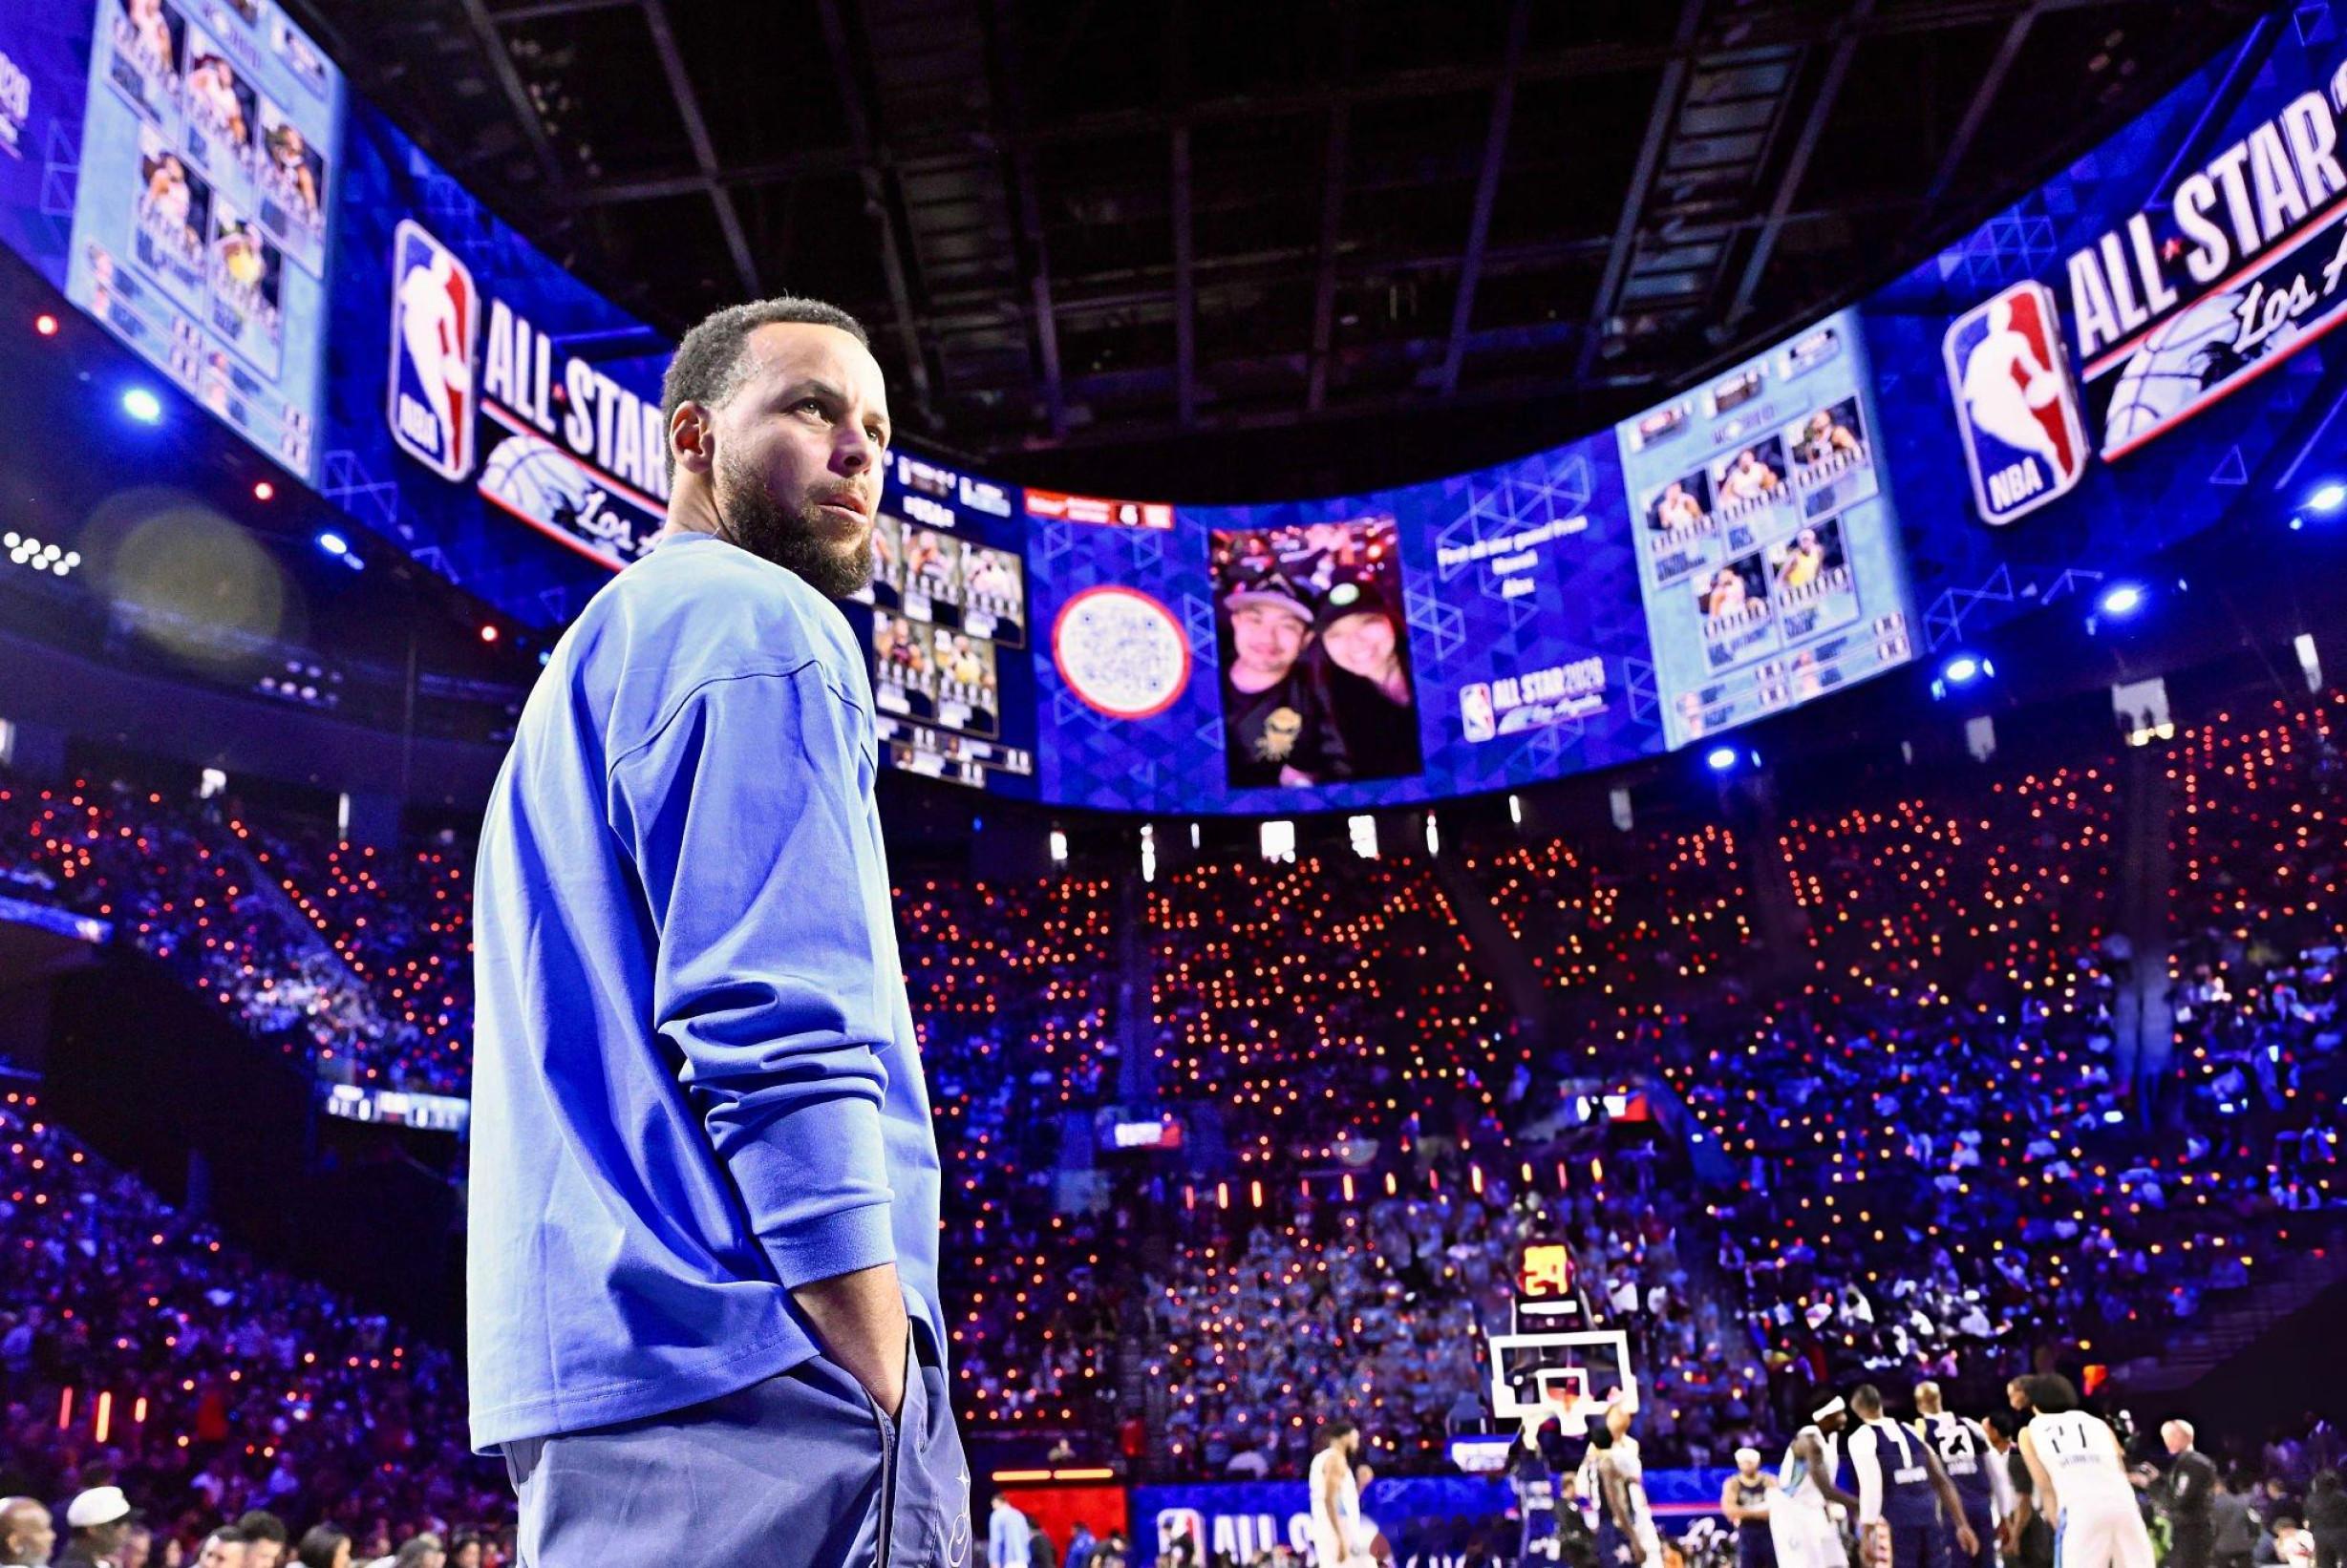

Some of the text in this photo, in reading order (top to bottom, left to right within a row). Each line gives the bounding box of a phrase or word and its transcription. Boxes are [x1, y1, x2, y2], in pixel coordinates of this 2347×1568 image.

[2065, 212, 2178, 359] ALL
[2172, 90, 2347, 284] STAR
[2232, 271, 2317, 353] Los
[483, 297, 556, 434] ALL
[575, 487, 635, 552] Los
[1988, 456, 2044, 512] NBA
[1491, 677, 1522, 713] ALL
[1521, 666, 1566, 705] STAR
